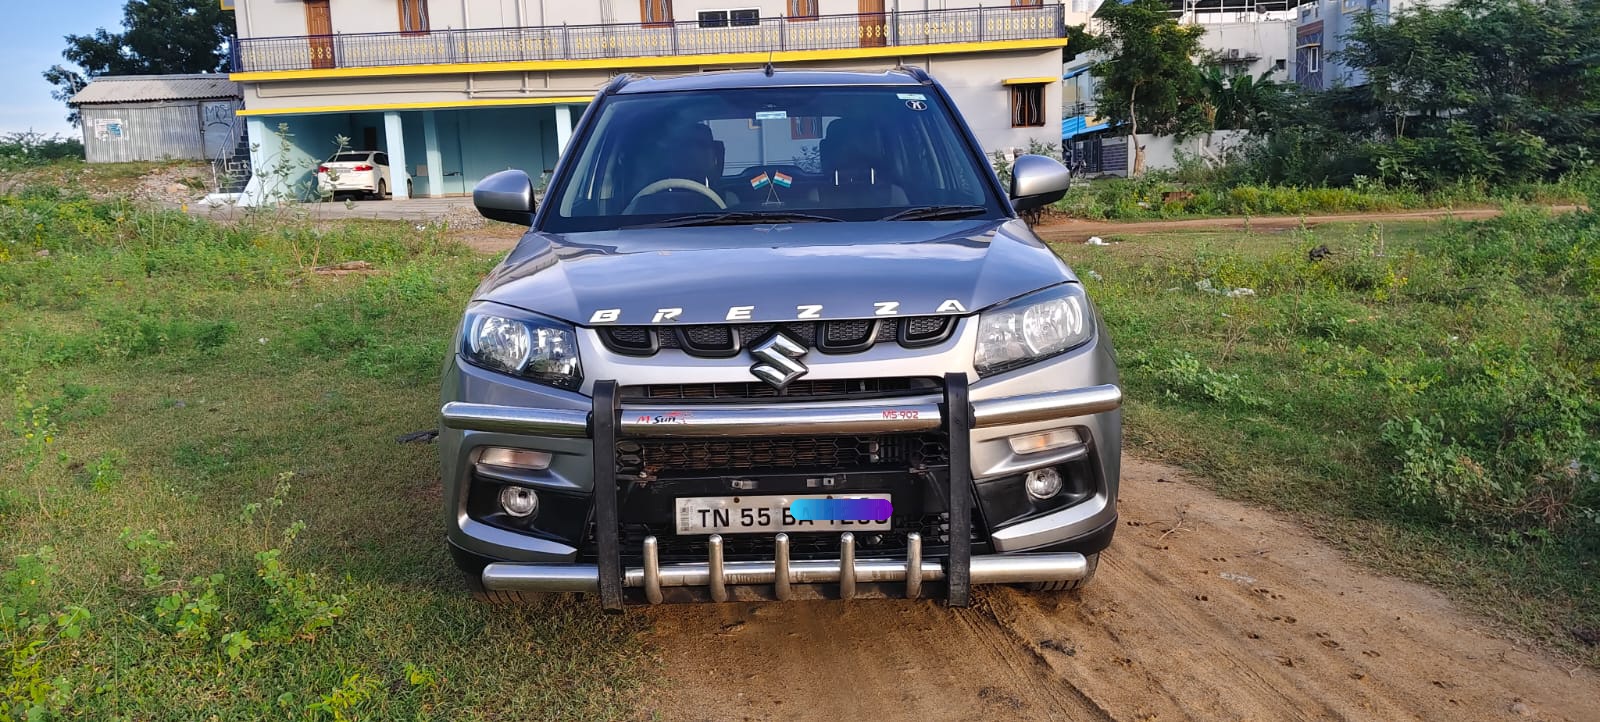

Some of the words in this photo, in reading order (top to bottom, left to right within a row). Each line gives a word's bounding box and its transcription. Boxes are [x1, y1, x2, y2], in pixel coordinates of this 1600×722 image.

[589, 299, 967, 323] BREZZA
[697, 508, 730, 528] TN
[741, 507, 771, 527] 55
